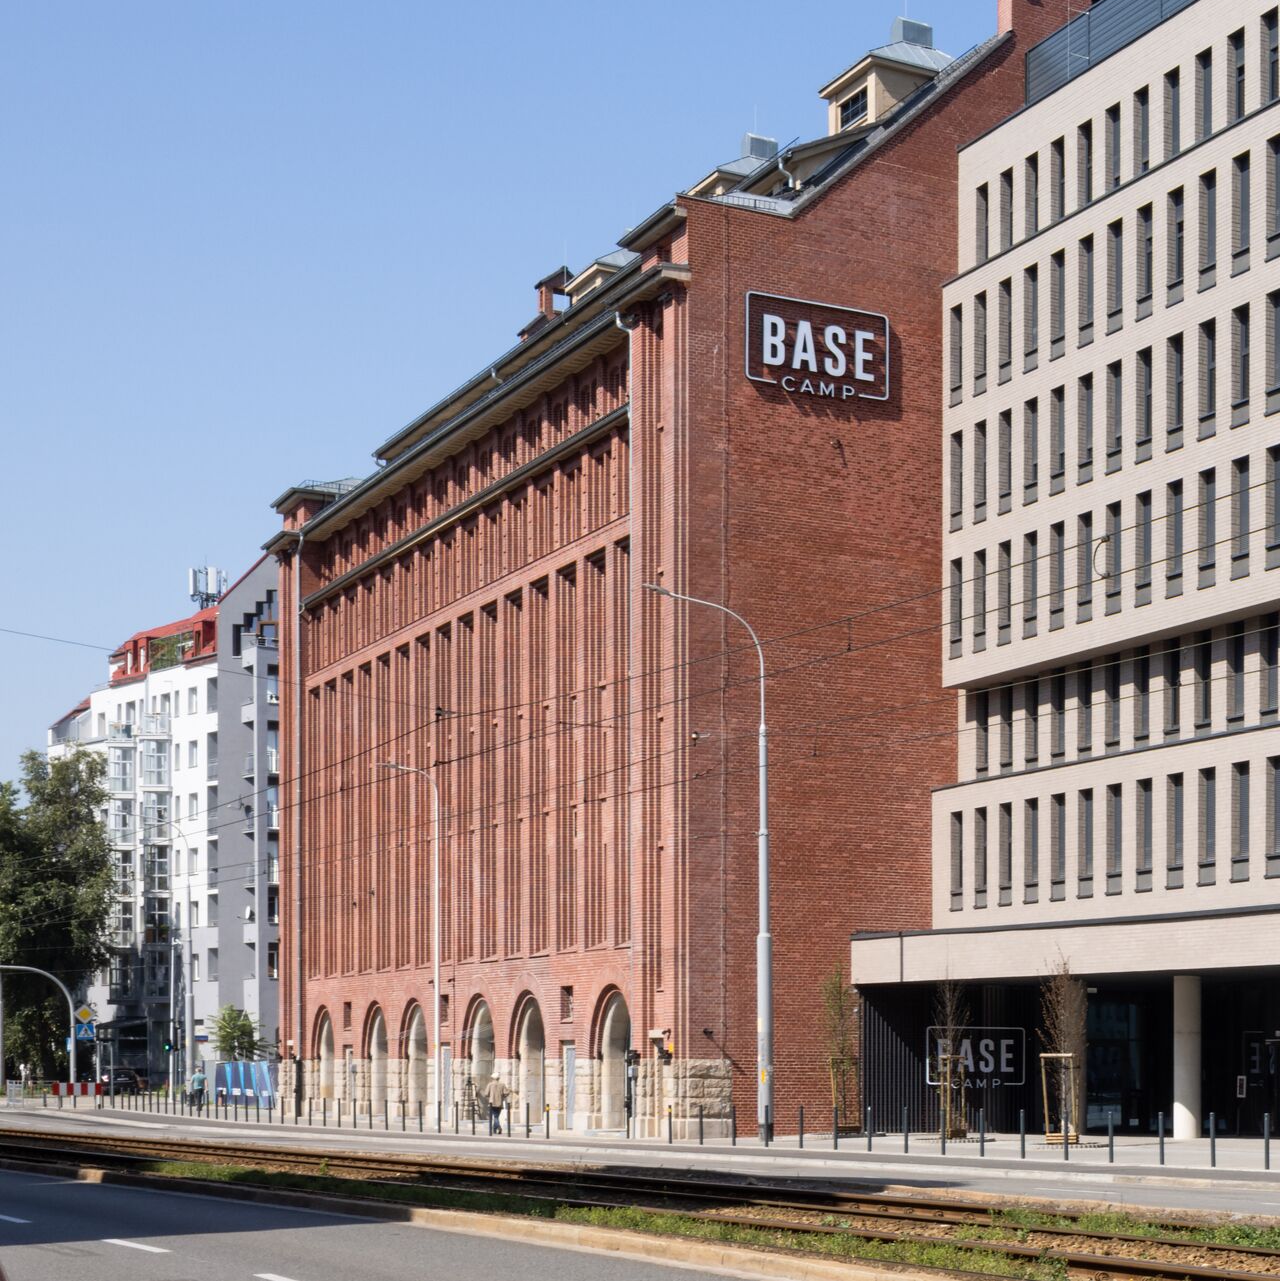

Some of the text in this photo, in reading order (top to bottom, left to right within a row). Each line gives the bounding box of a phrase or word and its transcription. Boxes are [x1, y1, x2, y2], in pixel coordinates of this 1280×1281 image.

[763, 313, 875, 382] BASE
[781, 376, 855, 400] CAMP
[951, 1078, 1001, 1089] CAMP
